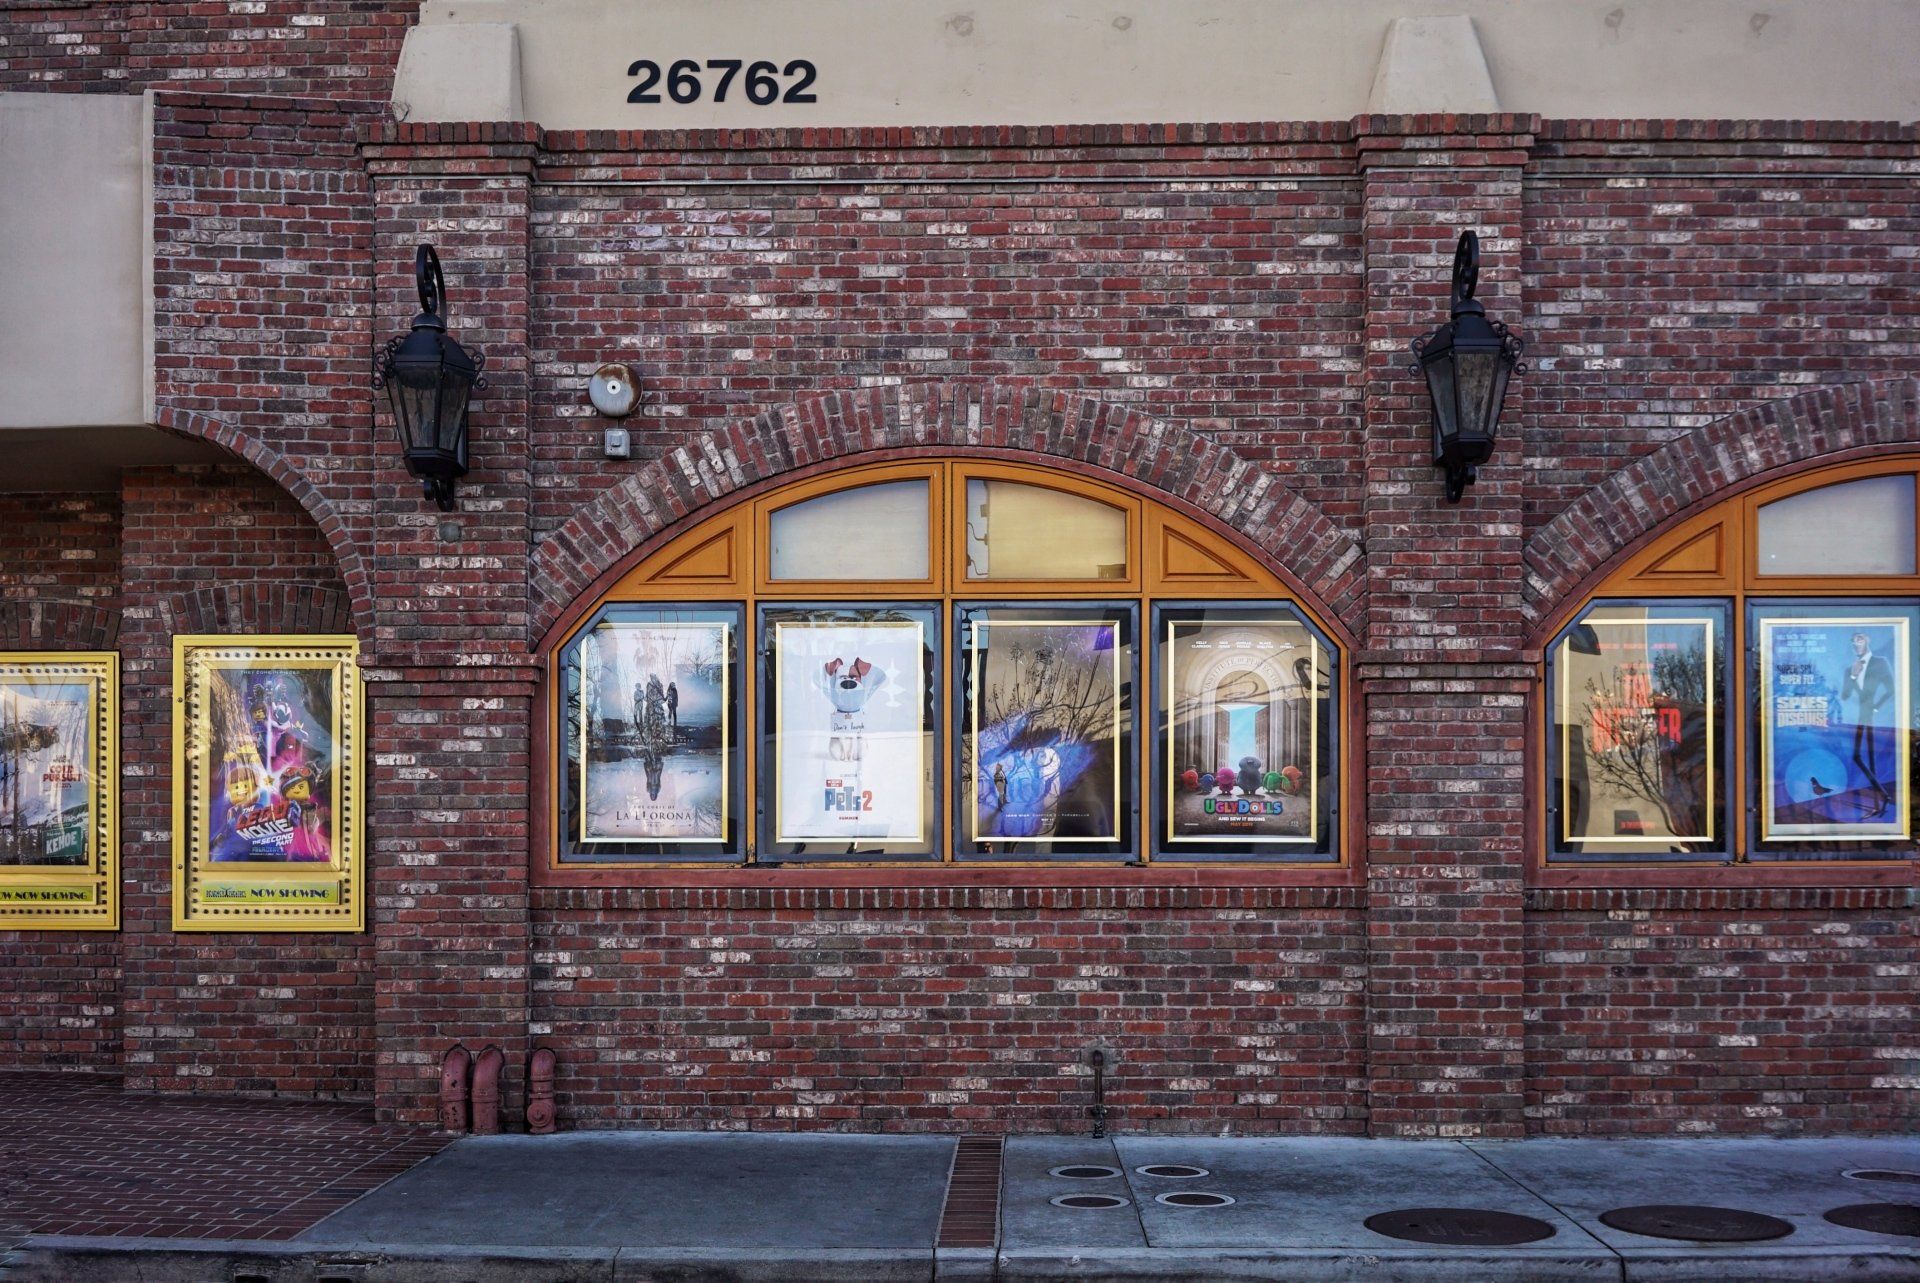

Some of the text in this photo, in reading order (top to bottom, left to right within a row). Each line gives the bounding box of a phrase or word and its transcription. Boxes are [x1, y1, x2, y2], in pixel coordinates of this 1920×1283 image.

[627, 59, 817, 105] 26762
[43, 773, 83, 782] PURSUIT
[862, 790, 873, 811] 2
[235, 800, 290, 830] LEGO
[242, 804, 255, 814] THE
[236, 818, 294, 841] MOVIE
[46, 831, 78, 855] KEHOE
[260, 832, 294, 846] SECOND
[275, 839, 294, 847] PART
[15, 892, 38, 900] NOW
[41, 892, 88, 900] SHOWING
[250, 889, 330, 898] NOW SHOWING
